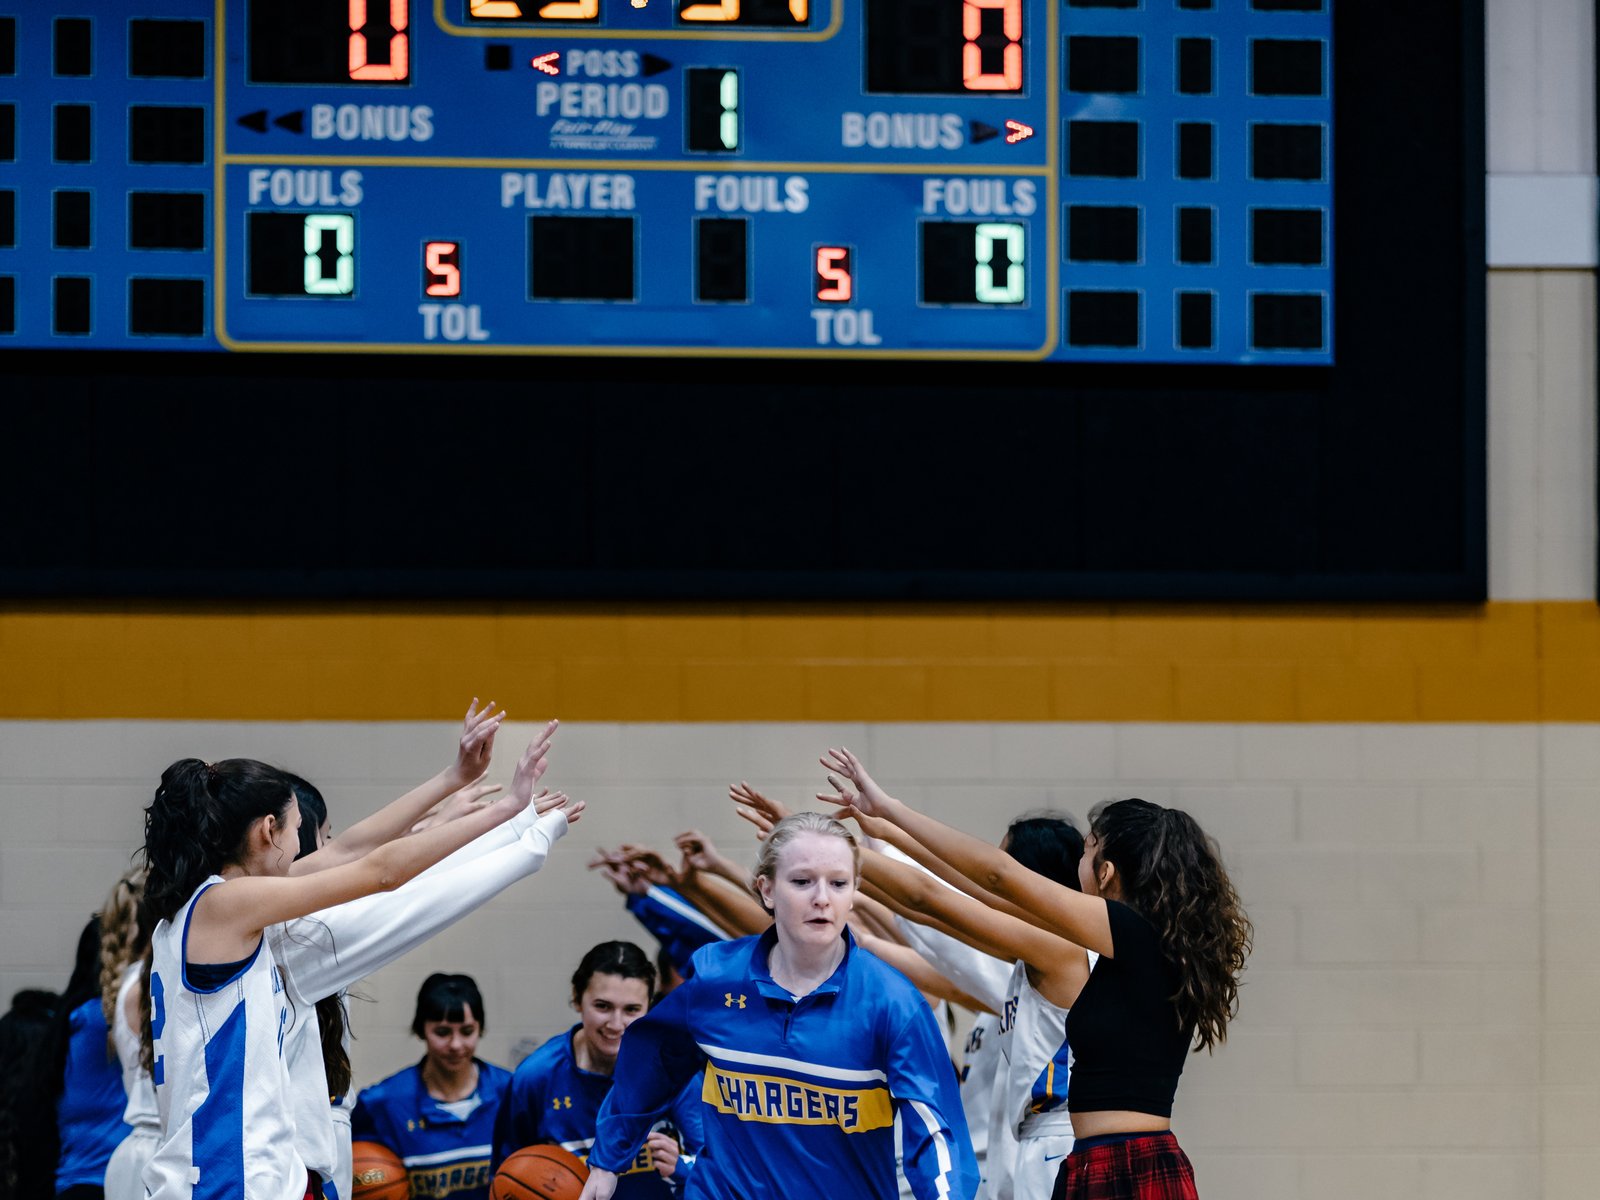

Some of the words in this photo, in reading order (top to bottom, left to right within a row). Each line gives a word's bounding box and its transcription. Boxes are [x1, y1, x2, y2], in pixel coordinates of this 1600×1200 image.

[565, 49, 638, 77] POSS
[962, 0, 1022, 90] 0
[536, 82, 669, 119] PERIOD
[719, 71, 738, 149] 1
[311, 104, 434, 141] BONUS
[841, 112, 964, 149] BONUS
[248, 169, 363, 206] FOULS
[501, 173, 635, 209] PLAYER
[695, 176, 809, 213] FOULS
[923, 179, 1036, 215] FOULS
[304, 214, 354, 295] 0
[426, 242, 460, 297] 5
[975, 223, 1025, 303] 0
[817, 247, 851, 301] 5
[418, 304, 489, 341] TOL
[811, 310, 882, 345] TOL
[715, 1073, 859, 1129] CHARGERS
